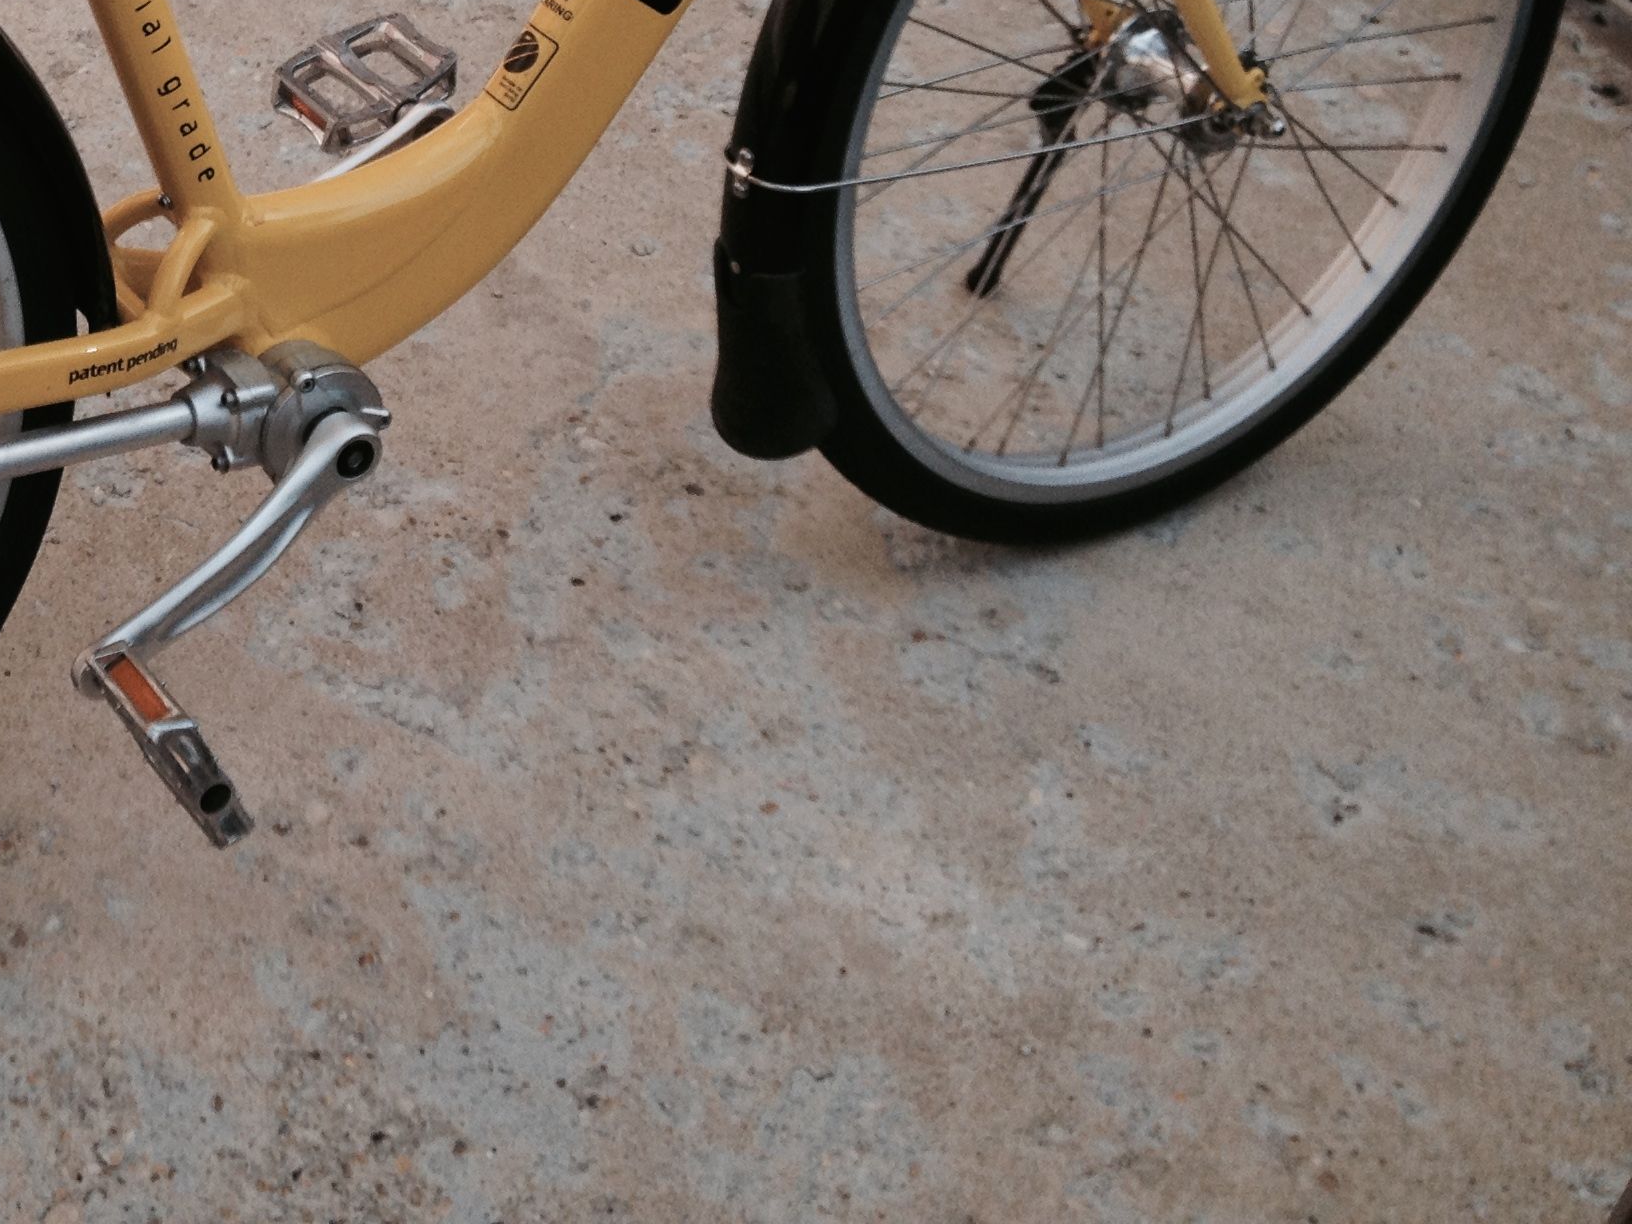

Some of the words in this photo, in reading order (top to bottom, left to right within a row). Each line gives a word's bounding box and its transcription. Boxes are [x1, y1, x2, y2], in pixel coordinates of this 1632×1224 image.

[157, 74, 216, 184] grade
[69, 358, 125, 385] patent
[126, 338, 179, 371] pending
